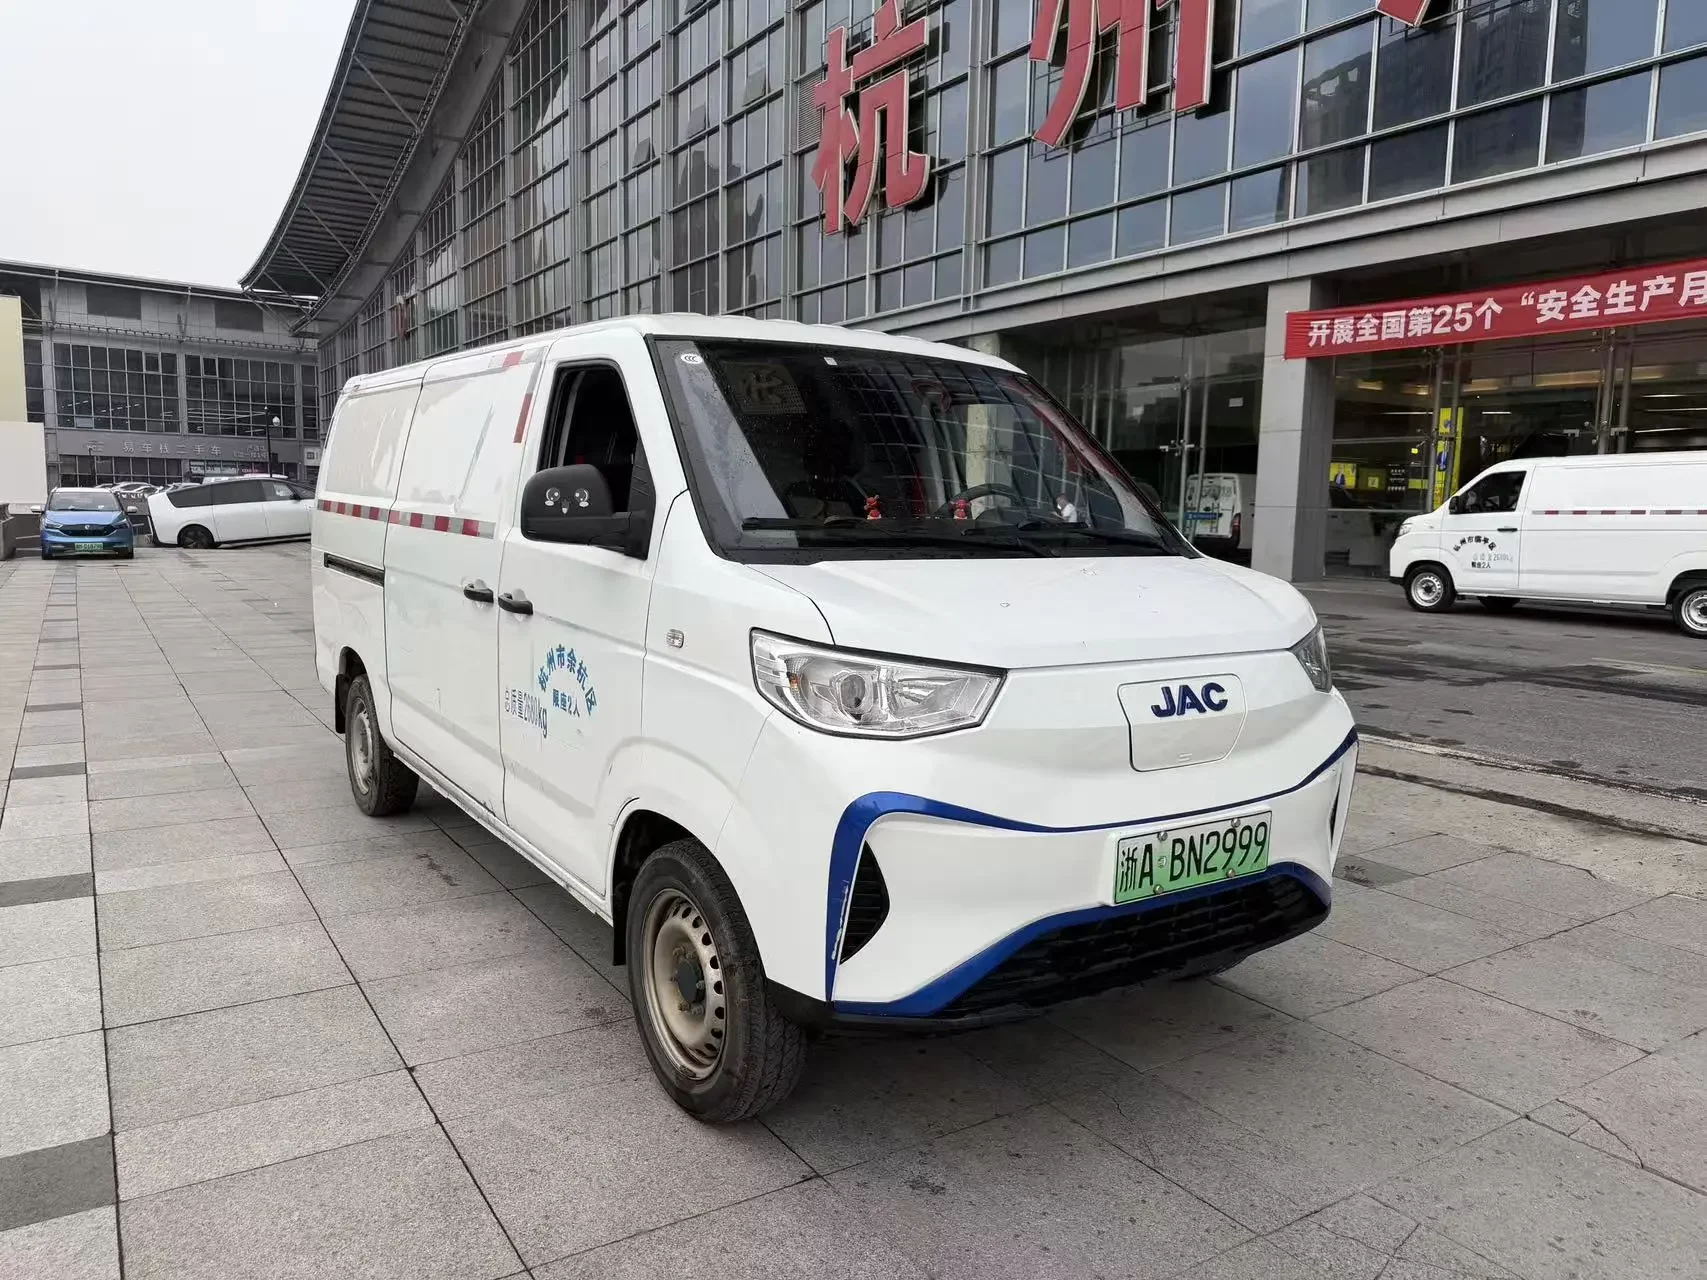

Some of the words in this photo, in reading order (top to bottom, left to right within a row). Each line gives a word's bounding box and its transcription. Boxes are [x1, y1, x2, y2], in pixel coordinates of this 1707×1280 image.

[1308, 297, 1503, 348] 开展全国第25个
[537, 643, 597, 717] 杭州市余杭区
[1150, 682, 1229, 718] JAC
[1118, 842, 1154, 893] 浙A
[1168, 821, 1269, 882] BN2999
